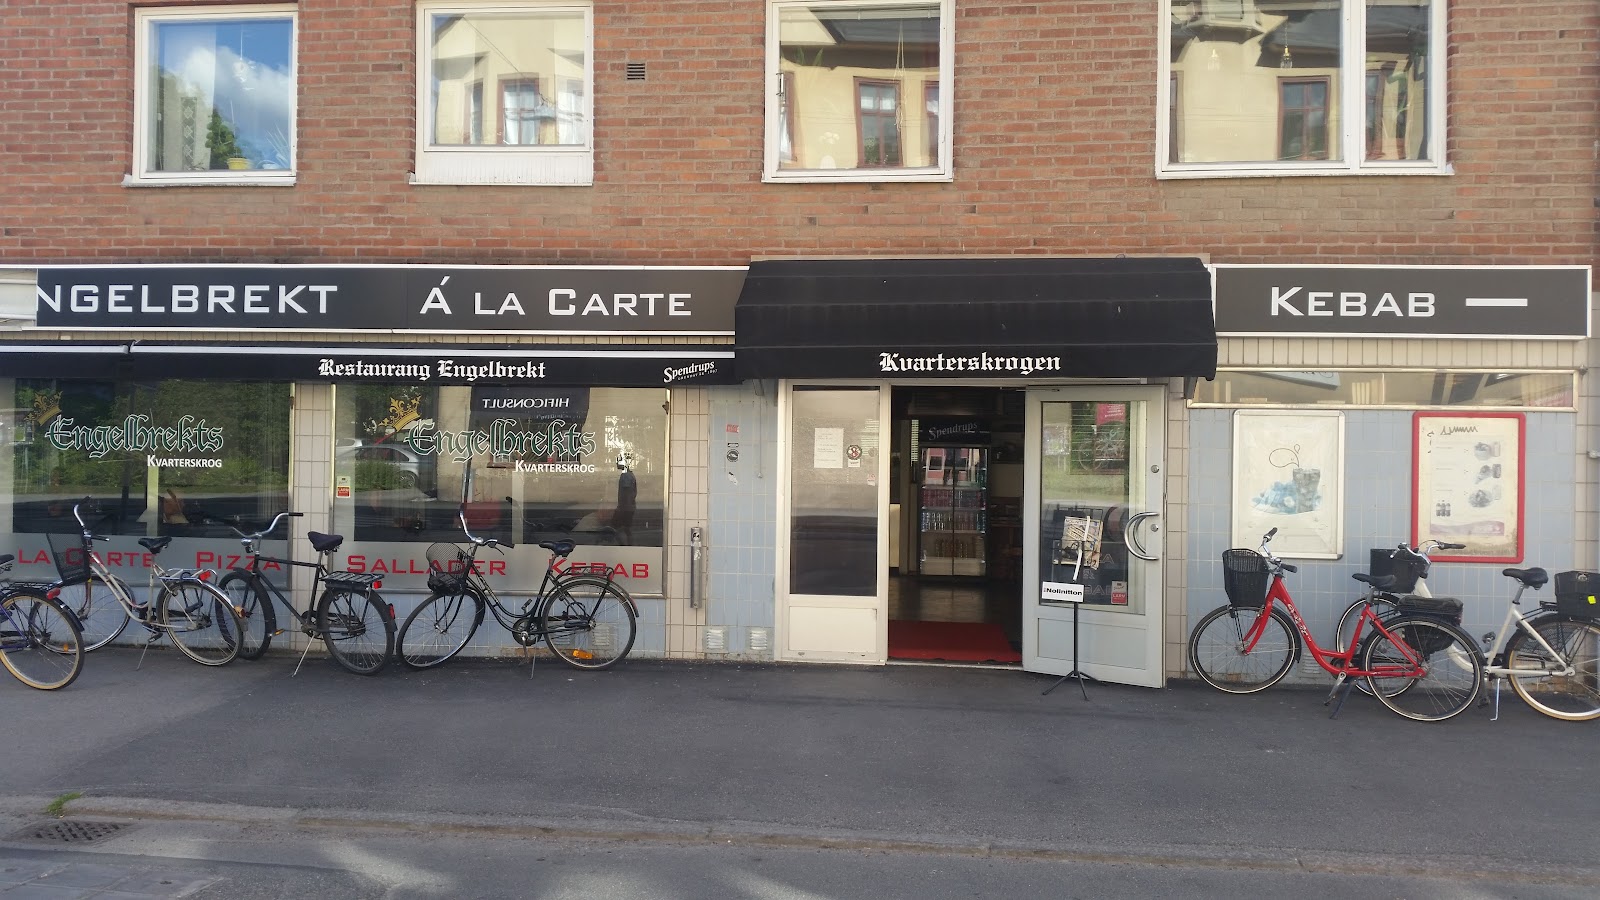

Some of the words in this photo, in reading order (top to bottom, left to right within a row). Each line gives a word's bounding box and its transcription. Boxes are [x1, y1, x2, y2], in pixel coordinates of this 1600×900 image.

[420, 276, 452, 315] Á
[474, 292, 526, 316] LA
[548, 288, 692, 316] CARTE
[1271, 286, 1436, 318] KEBAB
[318, 358, 431, 382] Restaurang
[437, 359, 546, 382] Engelbrekt
[663, 361, 715, 383] Spendrups
[879, 351, 1061, 376] Kvarterskrogen
[45, 414, 223, 459] Engelbrekts
[403, 418, 597, 463] Engelbrekts
[928, 422, 978, 441] Spendrups
[147, 454, 222, 468] KVARTERSKROG
[514, 460, 595, 474] KVARTERSKROG
[18, 549, 51, 564] LA
